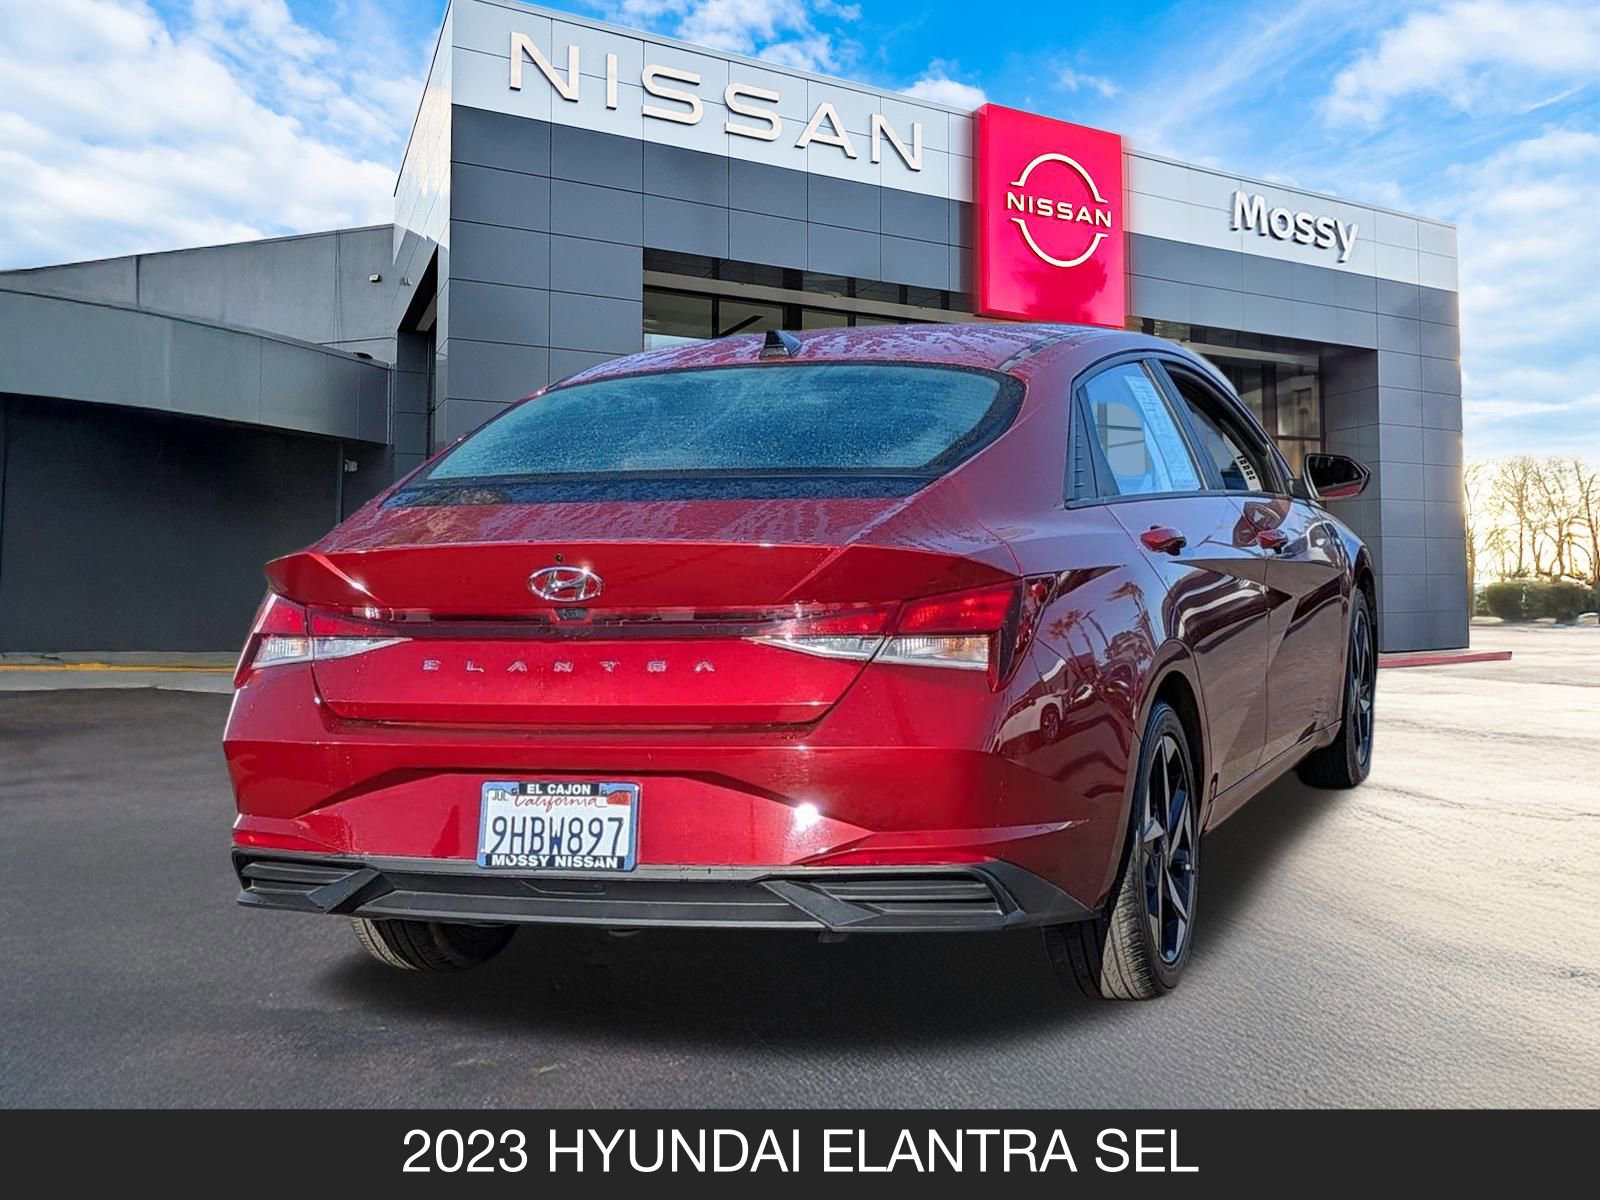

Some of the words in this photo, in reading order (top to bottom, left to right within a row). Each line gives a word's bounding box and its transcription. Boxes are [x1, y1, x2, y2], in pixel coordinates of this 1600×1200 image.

[509, 31, 922, 171] NISSAN
[1006, 190, 1112, 228] NISSAN
[1231, 190, 1359, 263] Mossy
[421, 658, 716, 674] ELANTRA
[513, 794, 607, 813] California
[526, 783, 543, 795] EL
[547, 783, 591, 796] CAJON
[491, 815, 624, 856] 9HBW897
[491, 854, 550, 867] MOSSY
[554, 855, 619, 869] NISSAN
